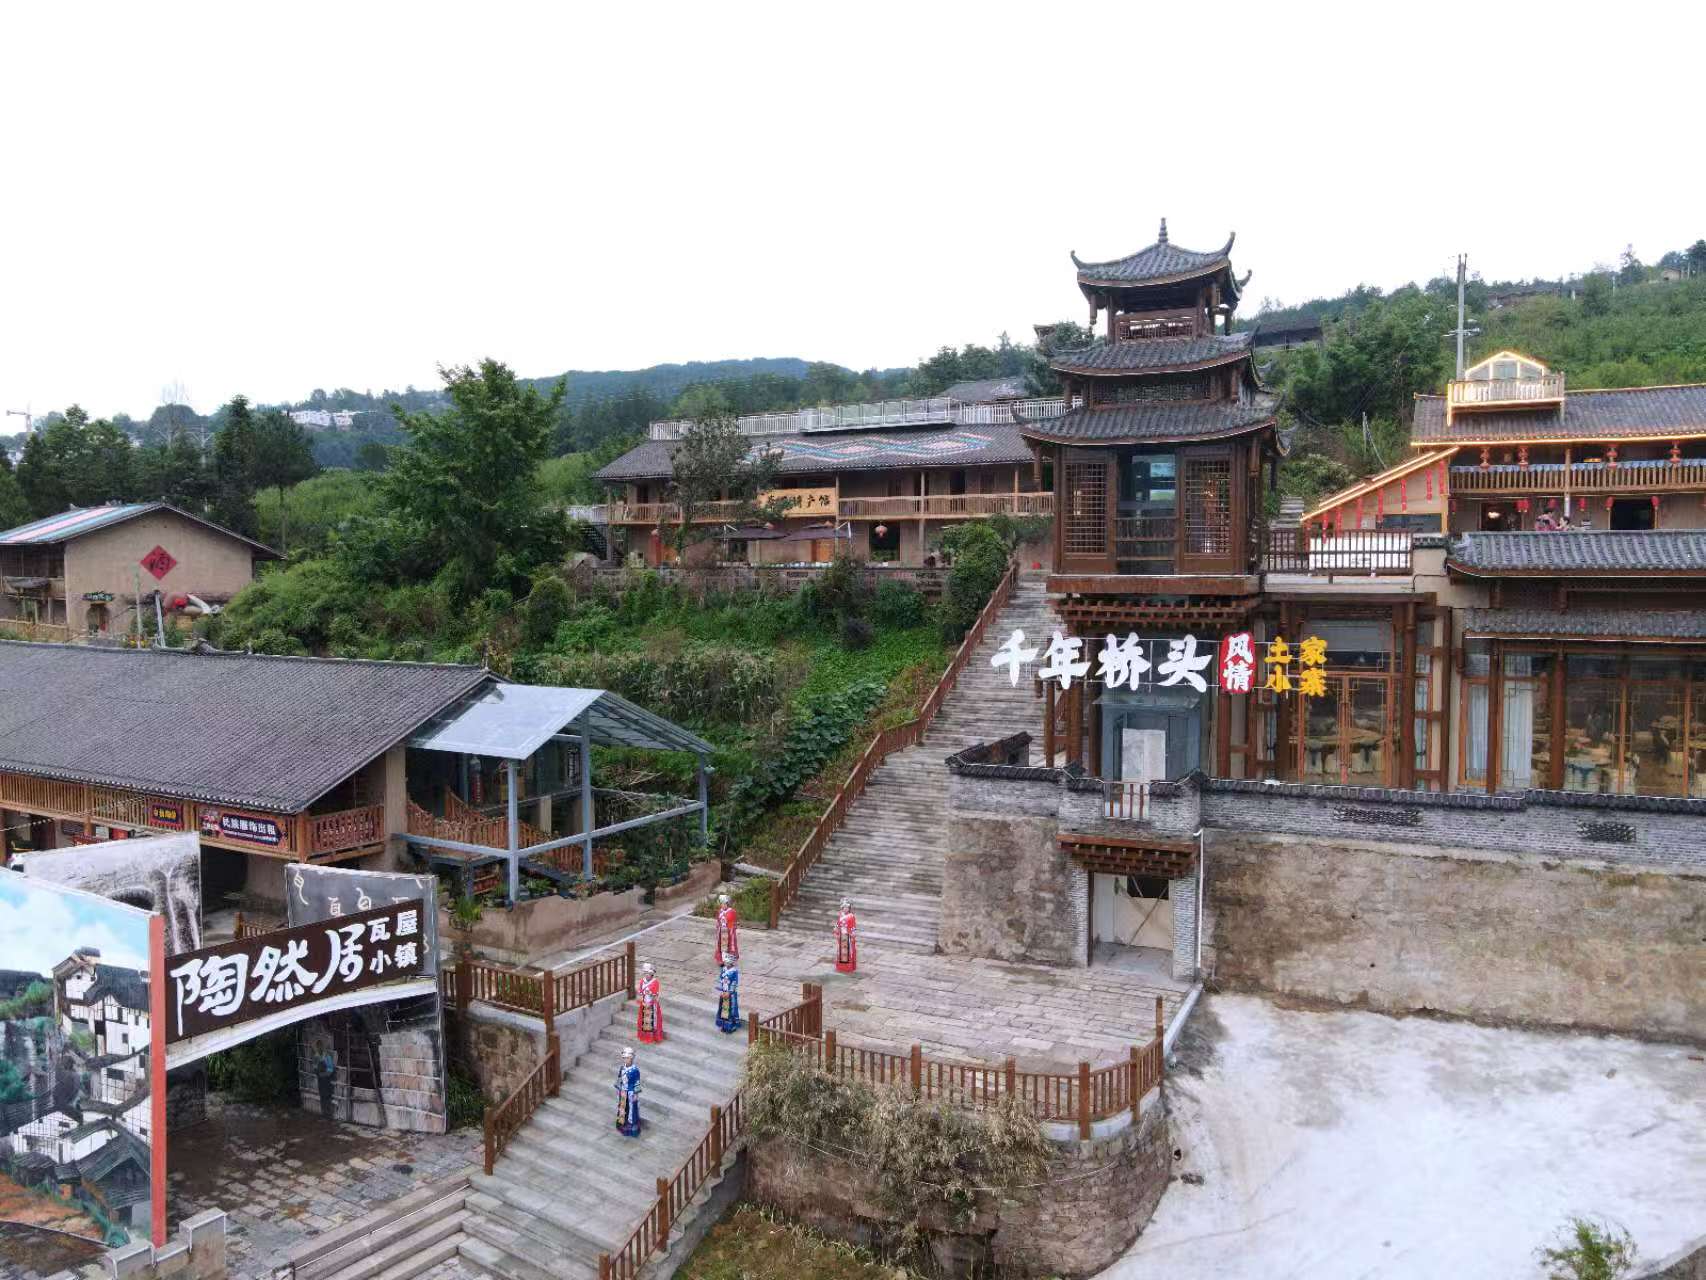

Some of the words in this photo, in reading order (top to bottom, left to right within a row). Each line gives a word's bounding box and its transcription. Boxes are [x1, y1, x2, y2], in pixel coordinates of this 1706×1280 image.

[991, 629, 1212, 693] 千年桥头
[1223, 633, 1254, 692] 风情
[1264, 636, 1328, 667] 土家
[1264, 664, 1328, 697] 小寨
[367, 909, 418, 944] 瓦屋
[369, 941, 418, 975] 小镇
[170, 923, 367, 1036] 陶然居
